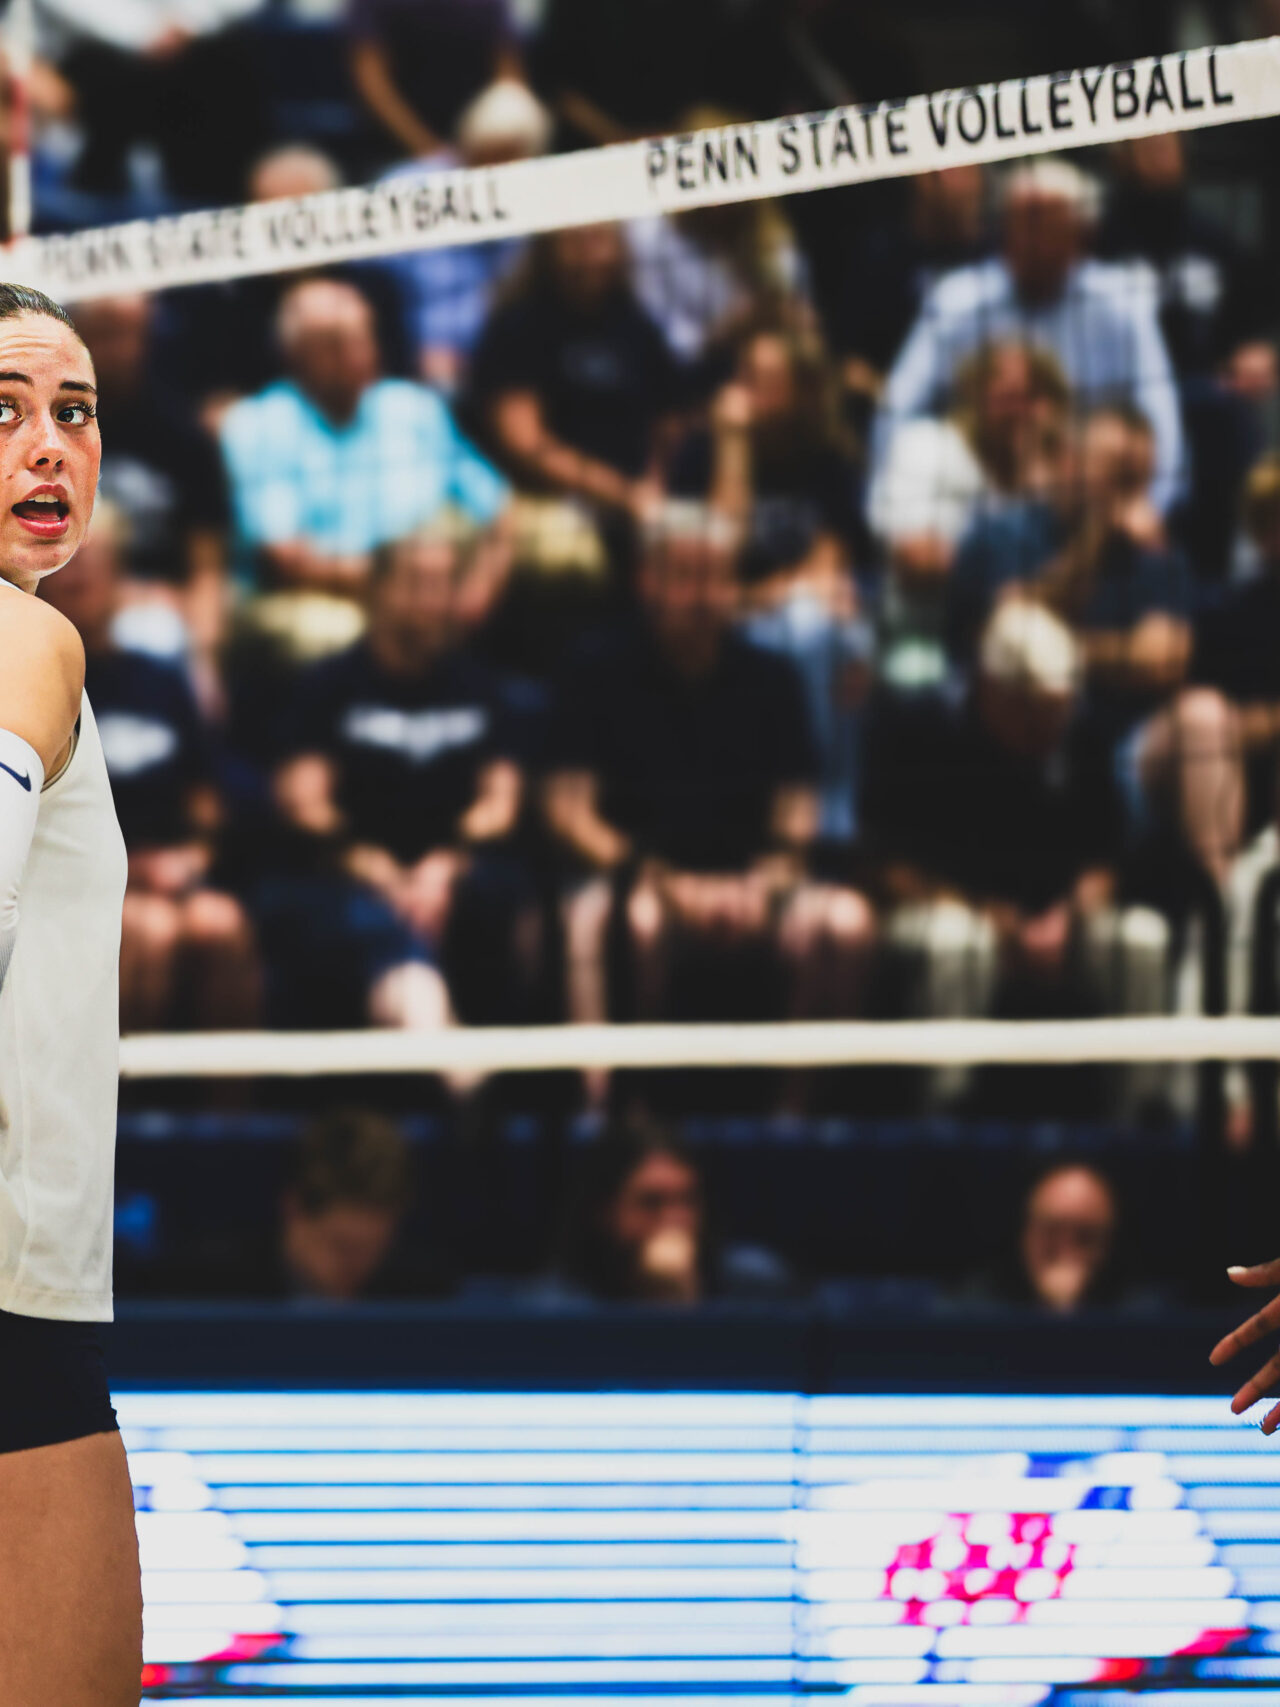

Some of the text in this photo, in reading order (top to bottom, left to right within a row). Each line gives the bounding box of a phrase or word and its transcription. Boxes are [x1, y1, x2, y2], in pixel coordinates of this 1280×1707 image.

[645, 47, 1234, 194] PENN STATE VOLLEYBALL
[263, 168, 509, 248] VOLLEYBALL
